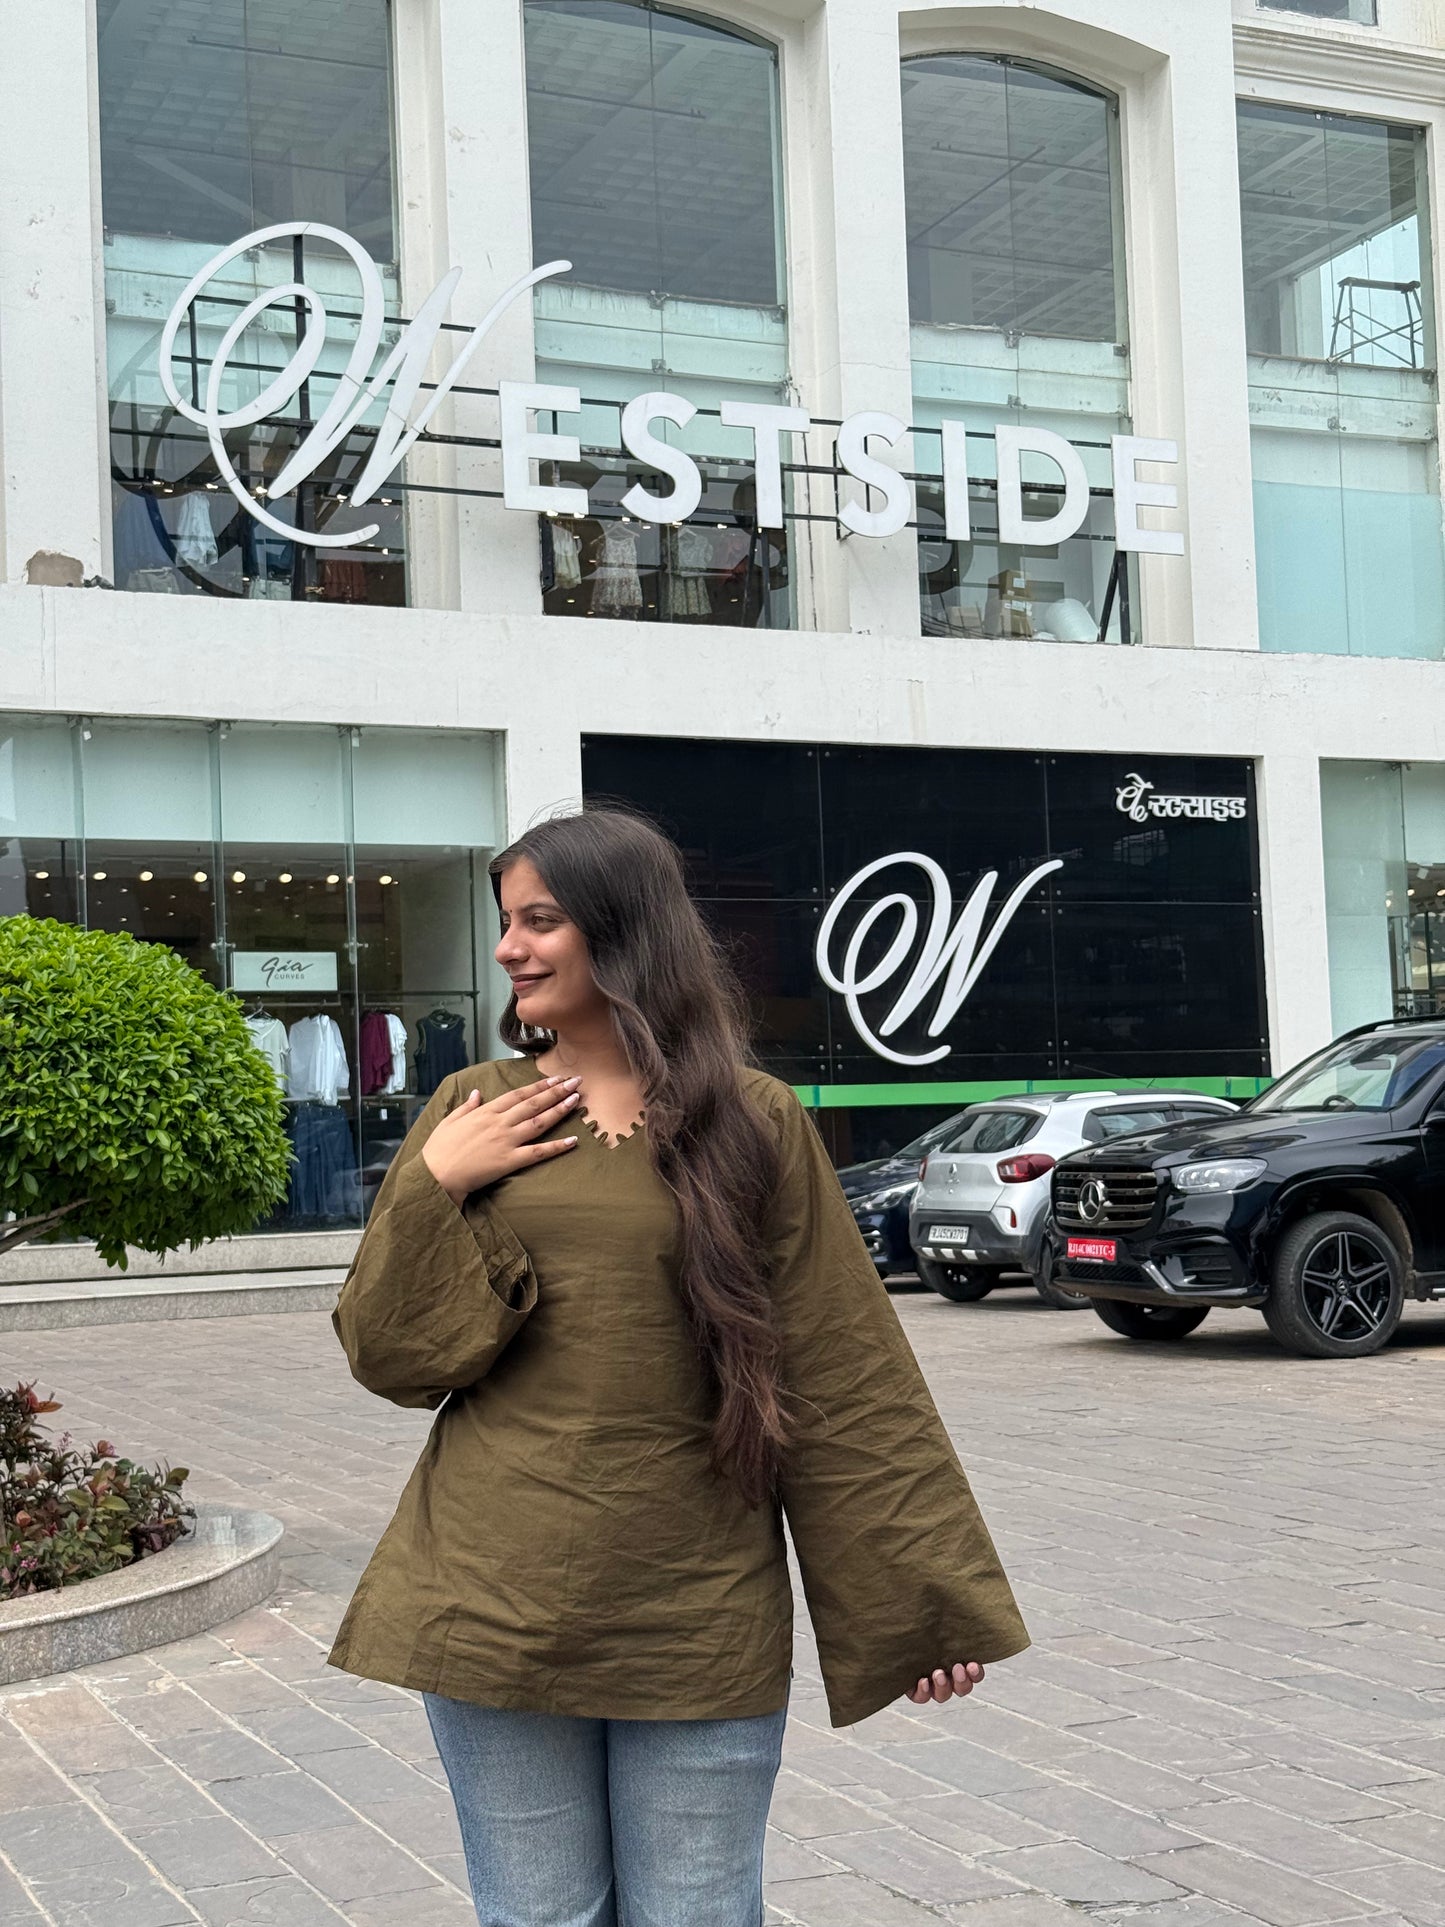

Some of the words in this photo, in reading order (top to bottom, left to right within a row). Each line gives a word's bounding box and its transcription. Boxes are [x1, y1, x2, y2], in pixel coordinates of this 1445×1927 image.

[159, 222, 1185, 555] WESTSIDE
[261, 956, 314, 988] Gia
[816, 851, 1064, 1066] W
